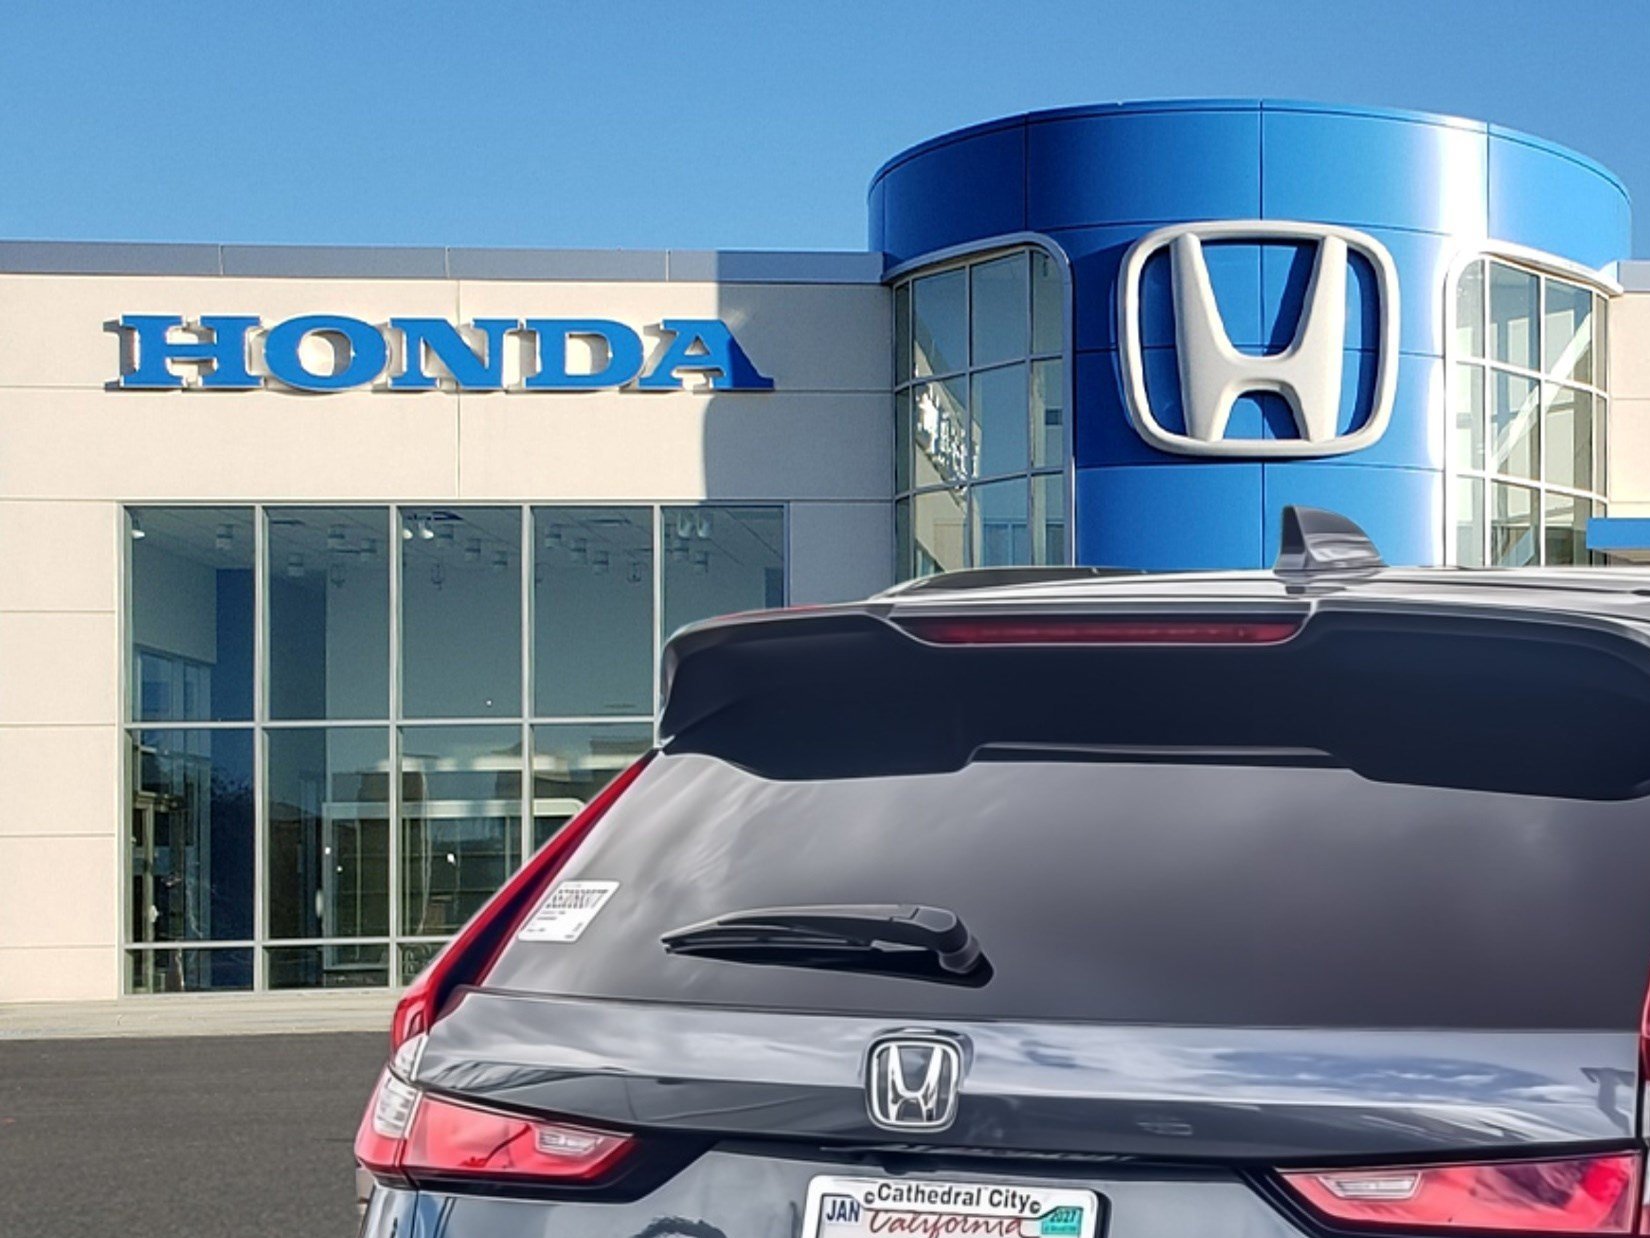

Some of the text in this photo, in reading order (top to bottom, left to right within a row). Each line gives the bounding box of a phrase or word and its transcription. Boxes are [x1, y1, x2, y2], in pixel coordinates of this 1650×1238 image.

[116, 315, 774, 392] HONDA
[826, 1199, 860, 1223] JAN
[877, 1182, 1032, 1215] Cathedral City
